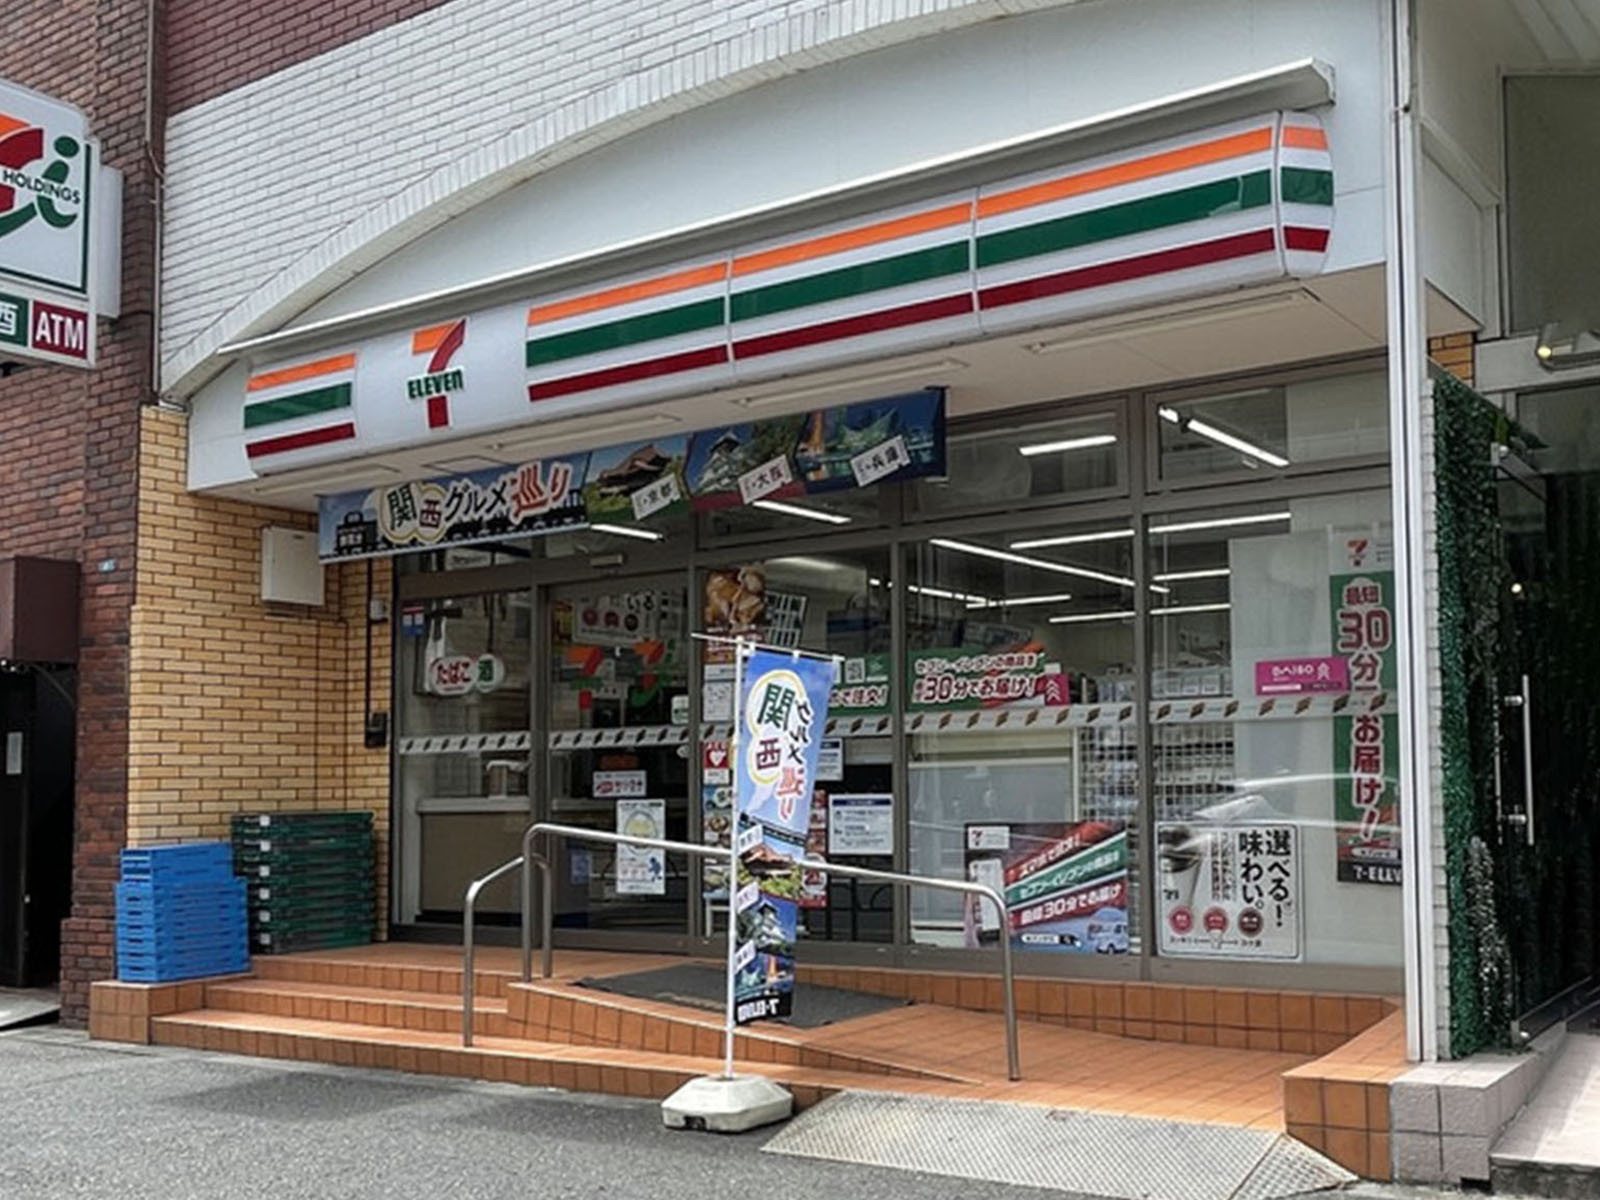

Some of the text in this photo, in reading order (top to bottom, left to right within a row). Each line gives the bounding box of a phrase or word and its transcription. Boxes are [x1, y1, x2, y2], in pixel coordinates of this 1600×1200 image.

[3, 169, 80, 204] HOLDINGS
[36, 311, 84, 351] ATM
[436, 661, 471, 685] たばこ
[1238, 829, 1265, 910] 味わい。
[1266, 829, 1291, 928] 選べる！
